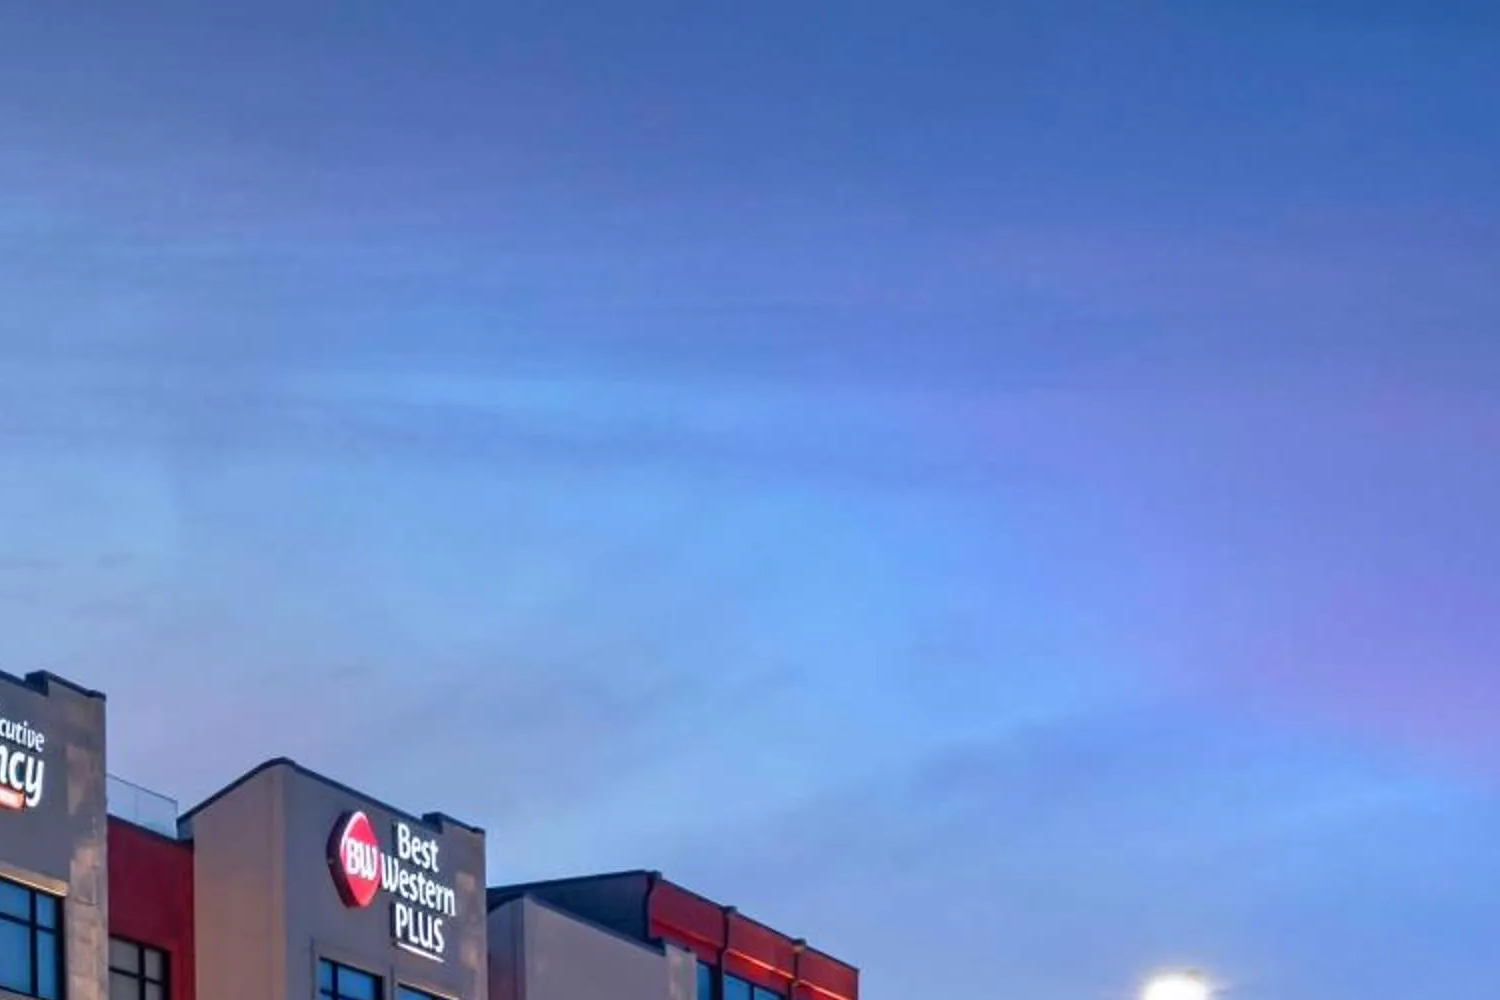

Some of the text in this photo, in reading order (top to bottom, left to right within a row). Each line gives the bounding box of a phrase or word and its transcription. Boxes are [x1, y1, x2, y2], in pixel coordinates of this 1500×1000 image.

[346, 838, 378, 881] BW
[397, 823, 439, 872] Best
[380, 852, 456, 916] Western
[395, 902, 445, 953] PLUS
